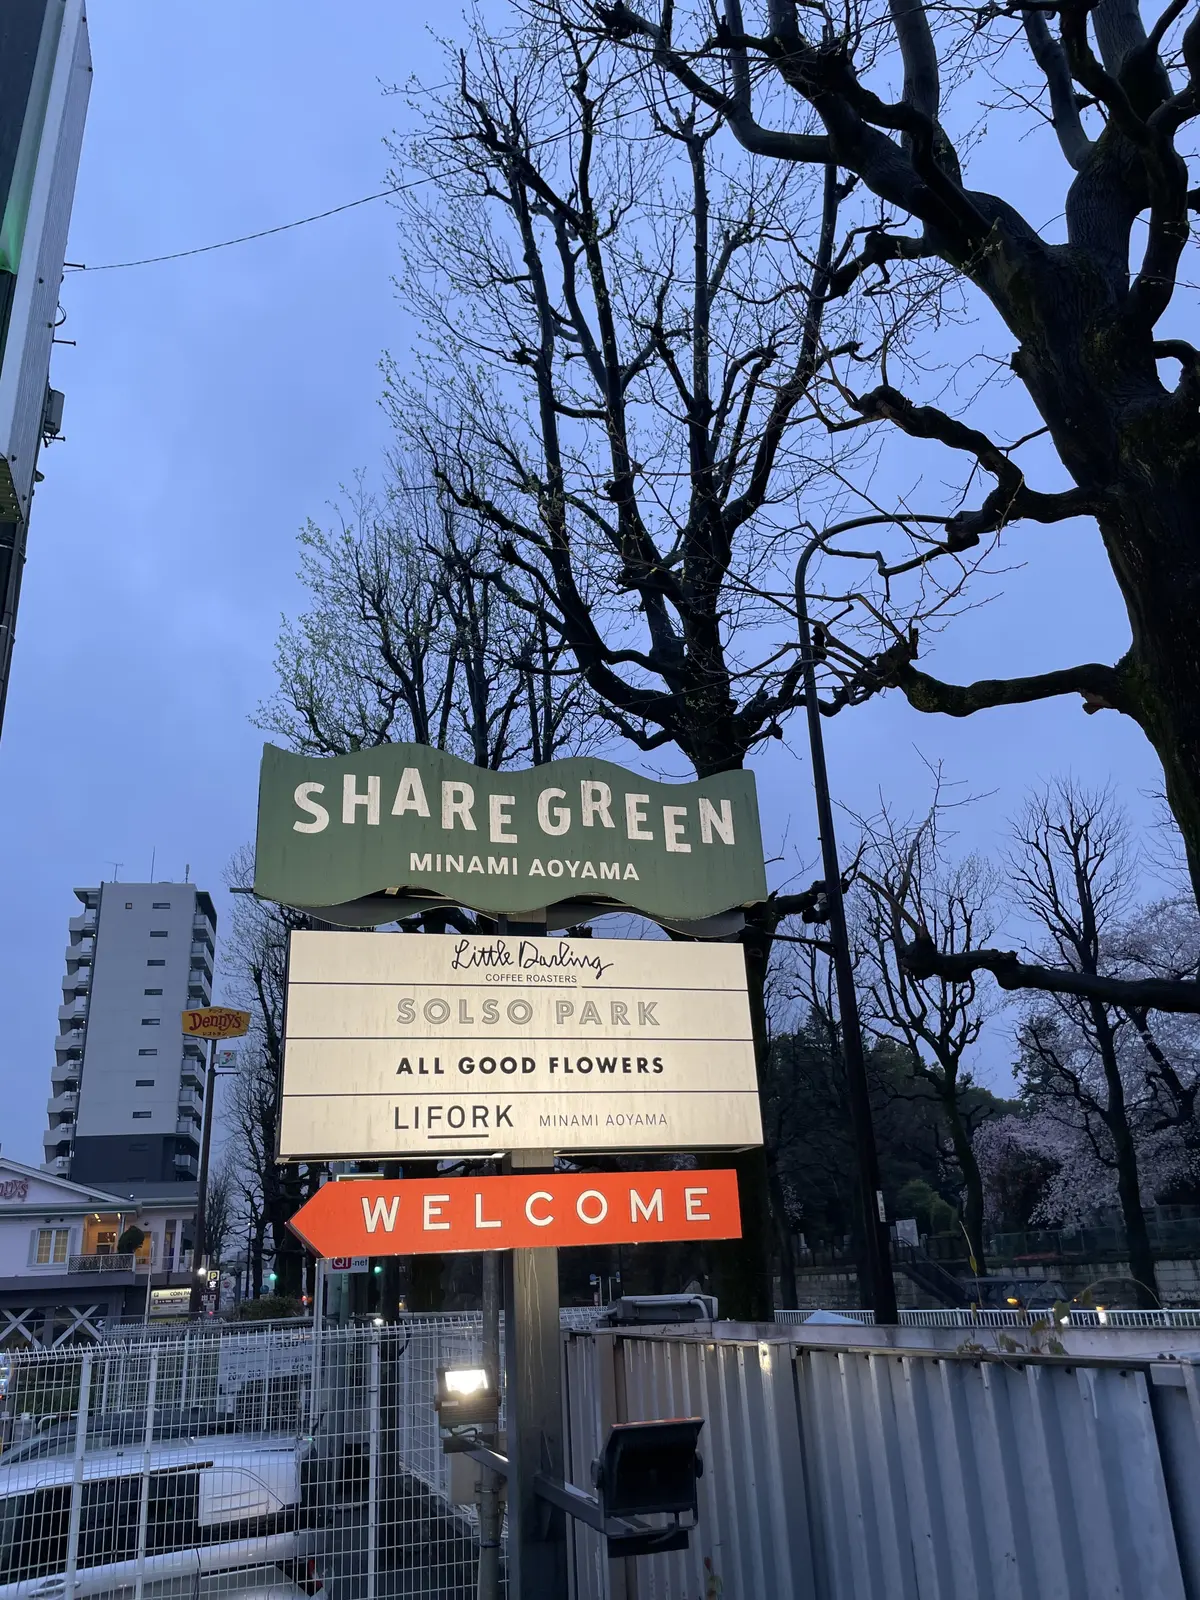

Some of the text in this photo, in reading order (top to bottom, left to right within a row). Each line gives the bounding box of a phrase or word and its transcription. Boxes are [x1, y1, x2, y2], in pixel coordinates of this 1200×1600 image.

[292, 766, 736, 853] SHARE GREEN
[409, 852, 640, 881] MINAMI AOYAMA
[451, 938, 614, 979] Little Darling
[485, 972, 578, 985] COFFEE ROASTERS
[188, 1012, 242, 1031] Denny's
[396, 997, 661, 1026] SOLSO PARK
[396, 1055, 664, 1075] ALL GOOD FLOWERS
[394, 1104, 668, 1130] LIFORK MINAMI AOYAMA
[360, 1186, 711, 1234] WELCOME
